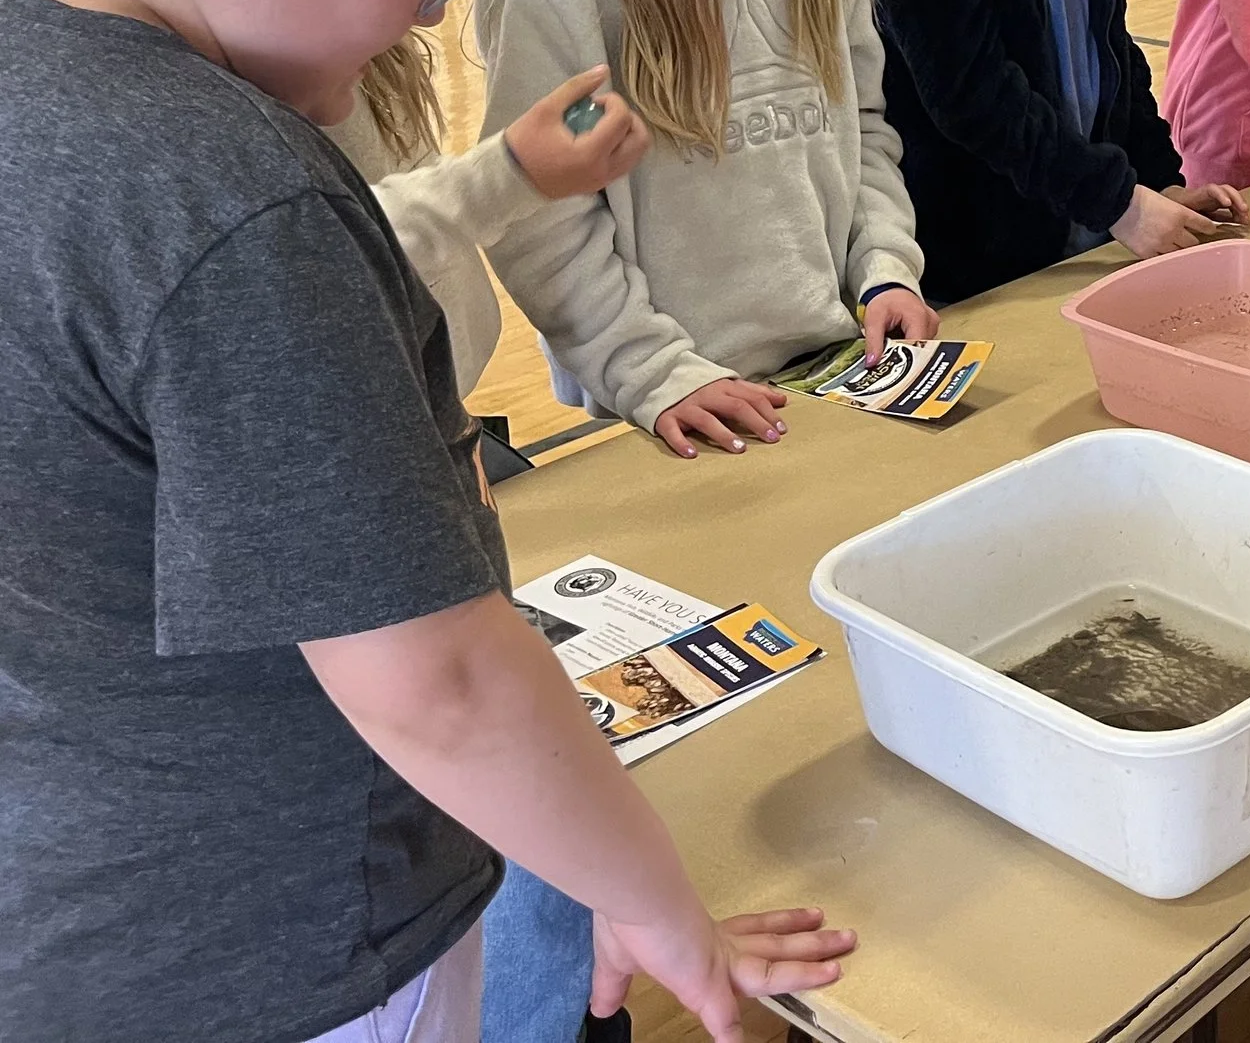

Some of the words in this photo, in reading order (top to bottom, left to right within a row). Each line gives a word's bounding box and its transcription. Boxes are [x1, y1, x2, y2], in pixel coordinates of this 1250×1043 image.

[617, 584, 661, 606] HAVE
[658, 598, 696, 619] YOU
[706, 641, 750, 673] MONTANA
[749, 630, 781, 653] WATERS
